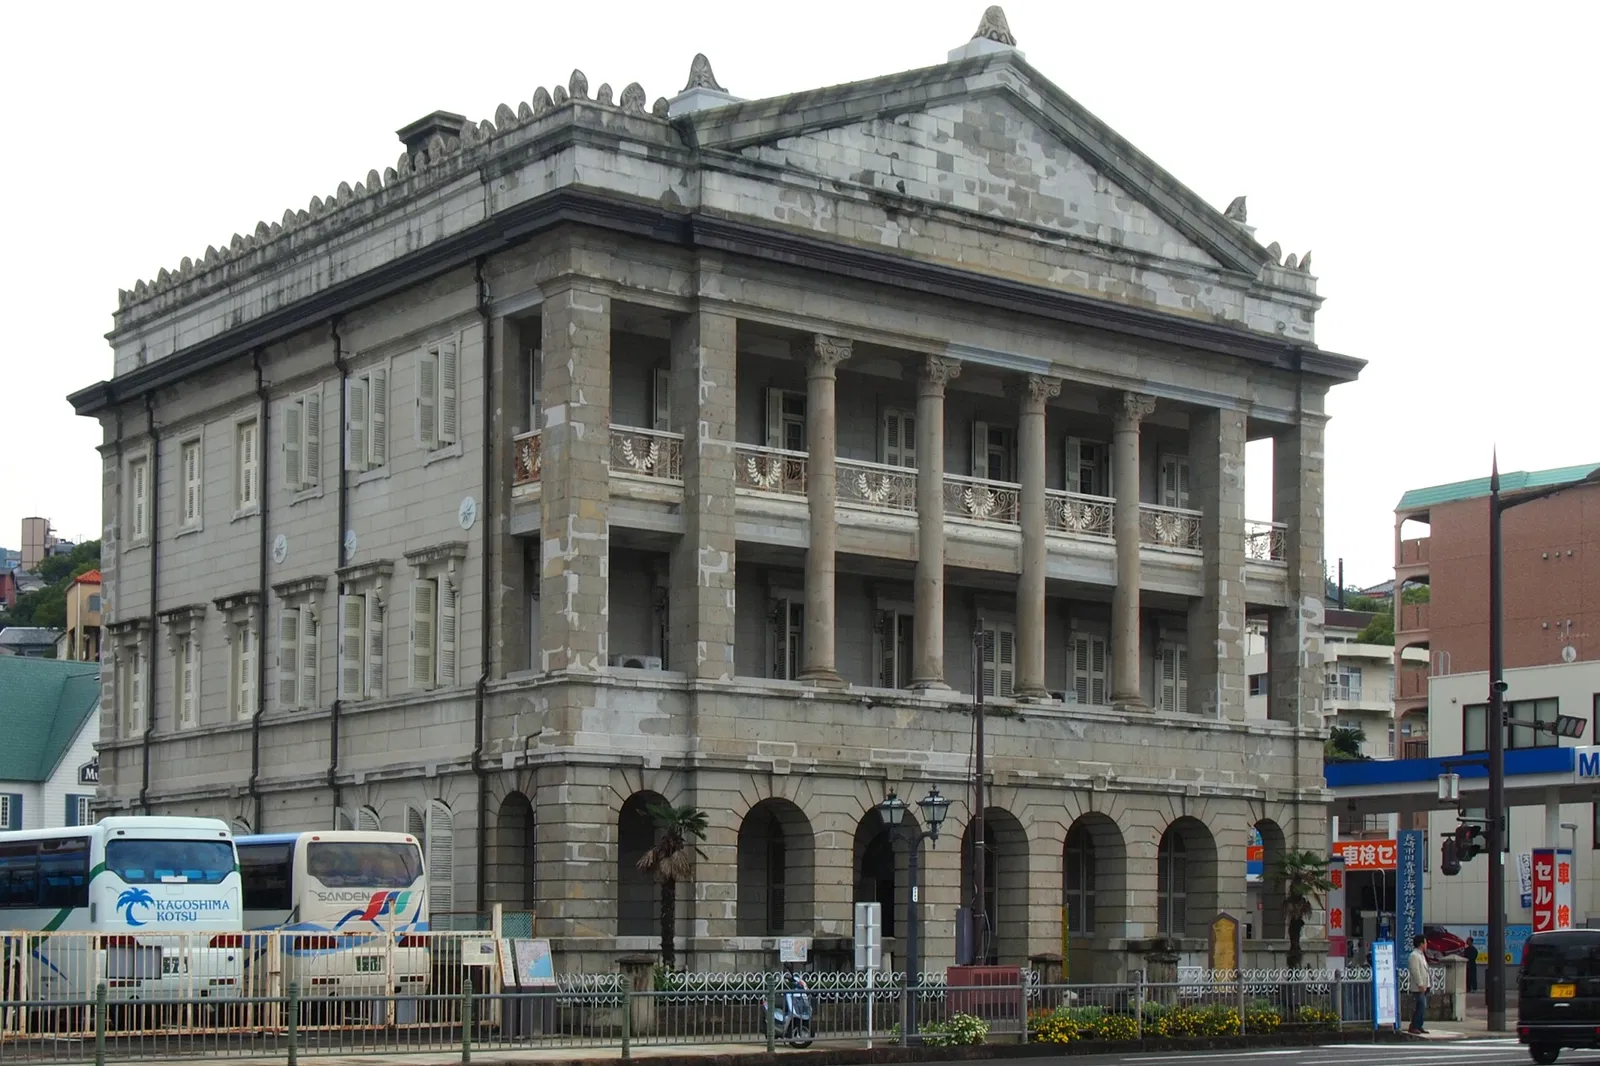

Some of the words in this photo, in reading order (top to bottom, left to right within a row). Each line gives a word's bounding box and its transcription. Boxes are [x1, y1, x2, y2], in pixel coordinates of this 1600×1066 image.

[1333, 844, 1397, 866] 車検セ
[318, 891, 371, 901] SANDEN
[1535, 861, 1552, 930] セルフ
[1557, 861, 1570, 928] 車検
[156, 899, 230, 910] KAGOSHIMA
[156, 911, 197, 922] KOTSU
